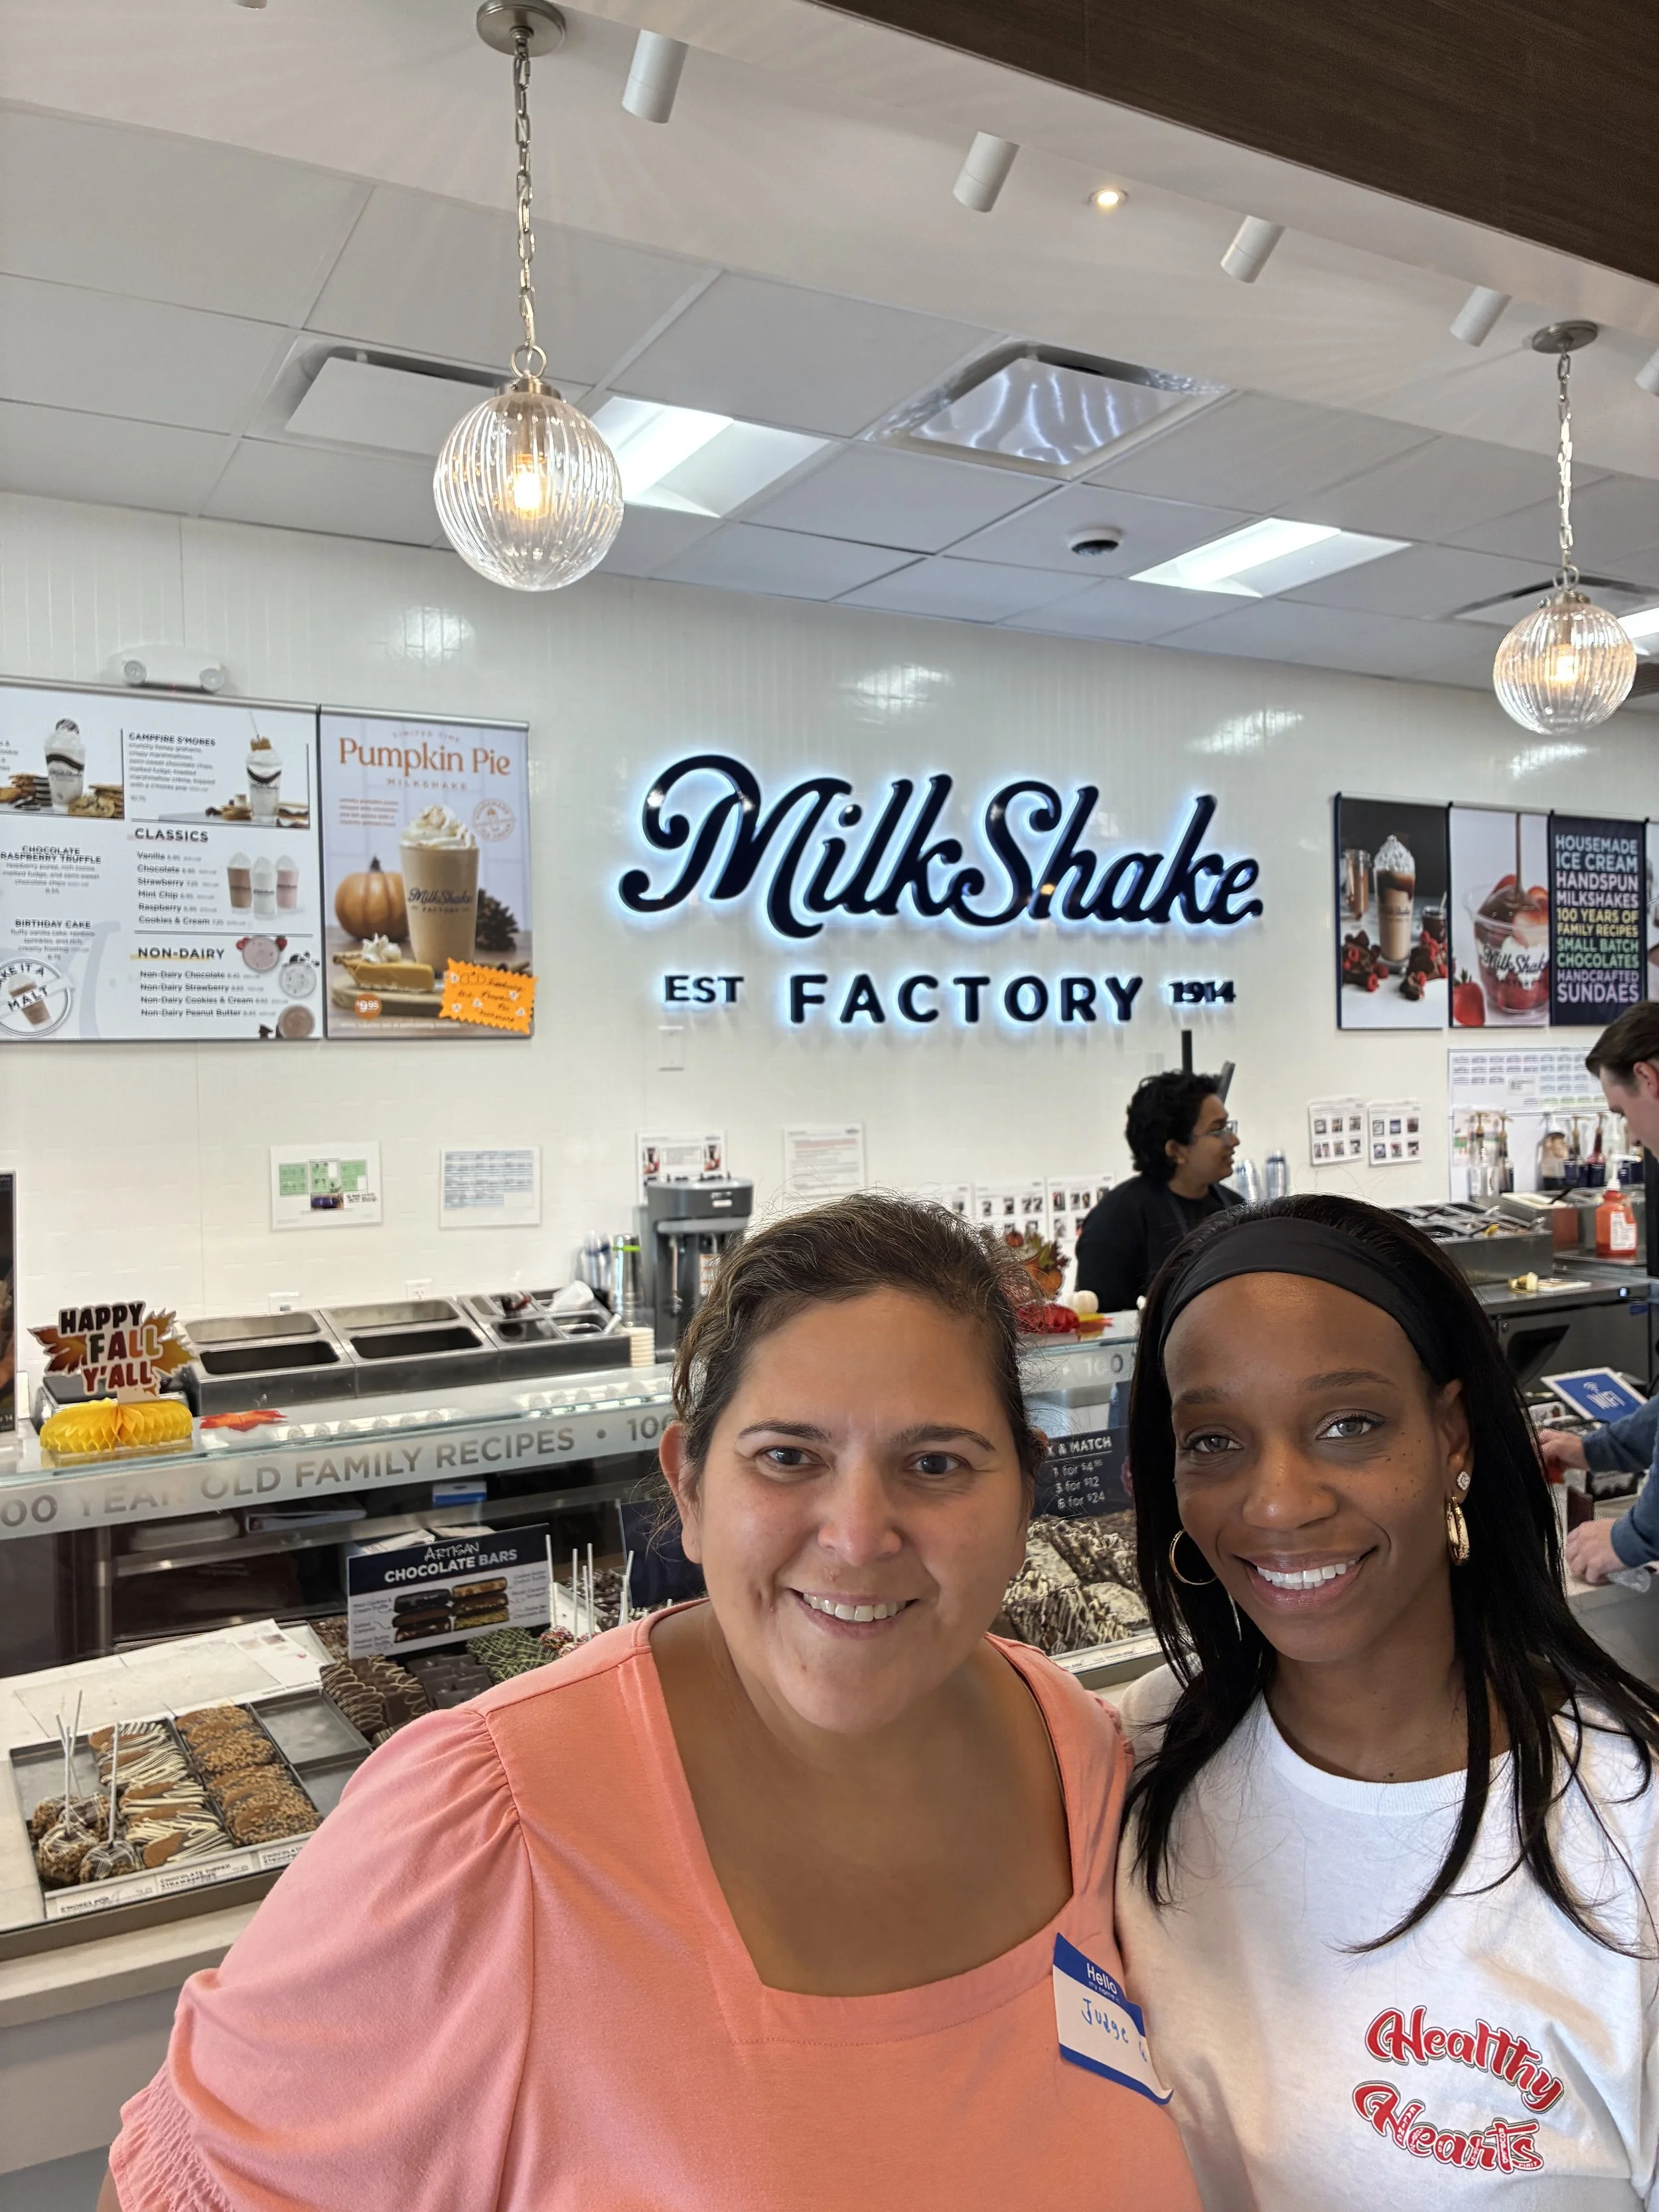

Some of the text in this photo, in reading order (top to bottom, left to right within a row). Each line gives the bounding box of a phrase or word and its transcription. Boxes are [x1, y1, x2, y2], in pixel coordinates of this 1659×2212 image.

[129, 732, 175, 744] CAMPFIRE
[339, 737, 512, 777] Pumpkin Pie
[387, 777, 468, 791] MILKSHAKE
[135, 828, 208, 843] CLASSICS
[22, 845, 80, 855] CHOCOLATE
[618, 753, 1263, 939] MilkShake
[1555, 834, 1638, 855] HOUSEMADE
[60, 853, 102, 865] TRUFFLE
[137, 851, 165, 861] Vanilla
[1555, 851, 1638, 873] ICE CREAM
[137, 864, 180, 874] Chocolate
[137, 877, 184, 887] Strawberry
[1556, 870, 1638, 892] HANDSPUN
[138, 890, 156, 899] Mint
[159, 891, 179, 901] Chip
[1556, 890, 1639, 909] MILKSHAKES
[138, 902, 181, 913] Raspberry
[1557, 907, 1639, 924] 100 YEARS OF
[15, 919, 91, 929] BIRTHDAY CAKE
[139, 915, 173, 924] Cookies
[183, 917, 210, 925] Cream
[1557, 922, 1639, 937] FAMILY RECIPES
[138, 946, 225, 960] NON-DAIRY
[1557, 936, 1639, 953] SMALL BATCH
[1481, 944, 1549, 974] MilkShak
[1557, 952, 1639, 969] CHOCOLATES
[21, 962, 33, 973] IT
[35, 966, 44, 977] A
[140, 970, 182, 980] Non-Dairy
[184, 970, 225, 979] Chocolate
[1557, 969, 1639, 983] HANDCRAFTED
[140, 983, 182, 992] Non-Dairy
[185, 983, 229, 993] Strawberry
[1557, 982, 1639, 1003] SUNDAES
[7, 985, 48, 1011] MALT
[141, 996, 183, 1005] Non-Dairy
[664, 974, 1237, 1024] EST FACTORY 1914
[141, 1009, 183, 1017] Non-Dairy
[60, 1302, 144, 1334] HAPPY
[89, 1327, 161, 1363] FALL
[83, 1361, 153, 1392] Y'ALL
[1070, 1436, 1112, 1453] MATCH
[201, 1466, 281, 1500] OLD
[296, 1446, 423, 1487] FAMILY
[437, 1427, 575, 1469] RECIPES
[1062, 1465, 1078, 1477] for
[1065, 1481, 1081, 1492] for
[1057, 1491, 1106, 1511] 6 for $24
[384, 1548, 518, 1584] CHOCOLATE BARS
[1086, 1962, 1118, 1995] Hello
[1081, 1998, 1129, 2044] Judge
[1364, 2005, 1564, 2114] Healthy
[1352, 2080, 1544, 2174] Hearts
